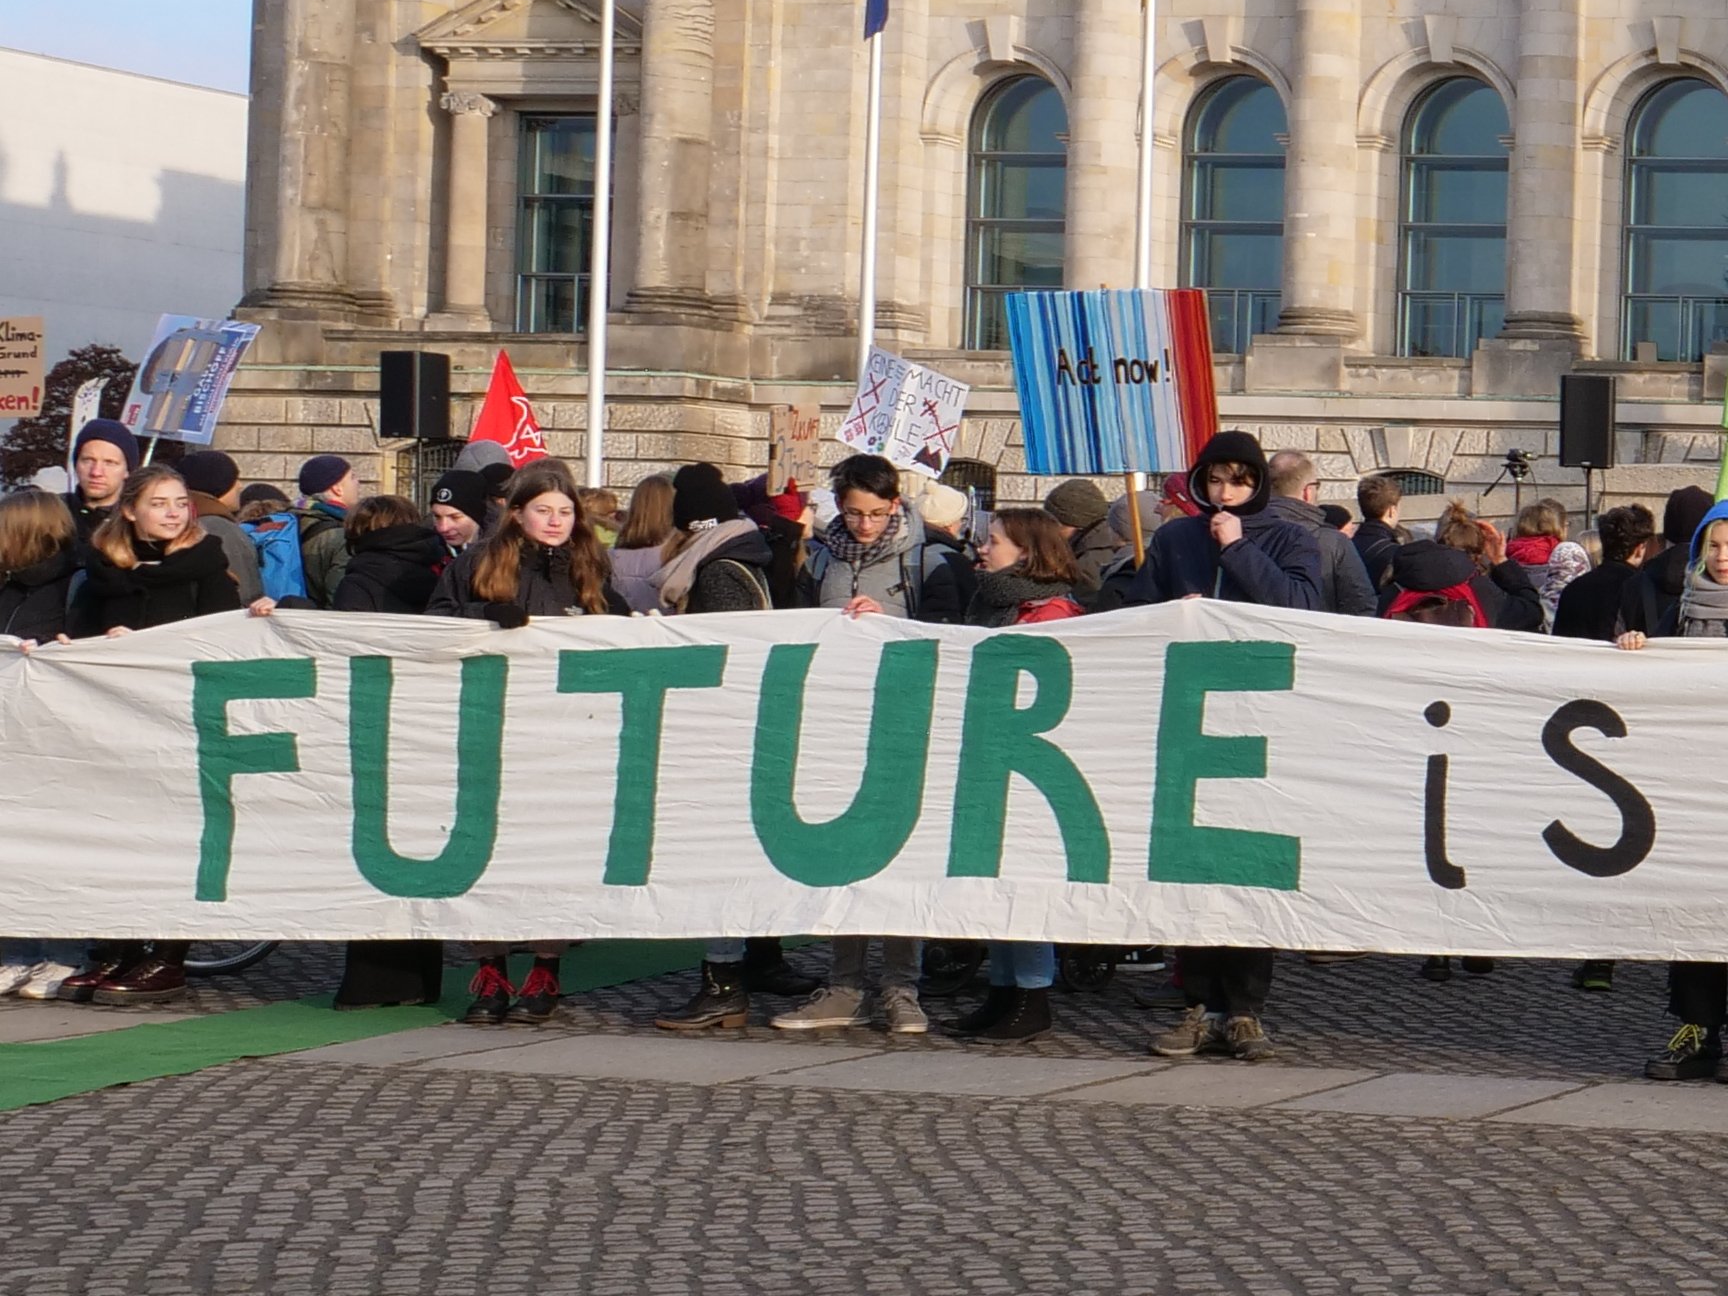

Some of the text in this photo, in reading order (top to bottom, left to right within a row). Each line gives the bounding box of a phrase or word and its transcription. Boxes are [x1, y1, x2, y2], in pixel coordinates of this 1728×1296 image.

[1057, 346, 1101, 385] Act
[888, 387, 917, 415] DER
[902, 368, 967, 407] MACHT
[191, 633, 1302, 903] FUTURE
[1423, 697, 1657, 890] is
